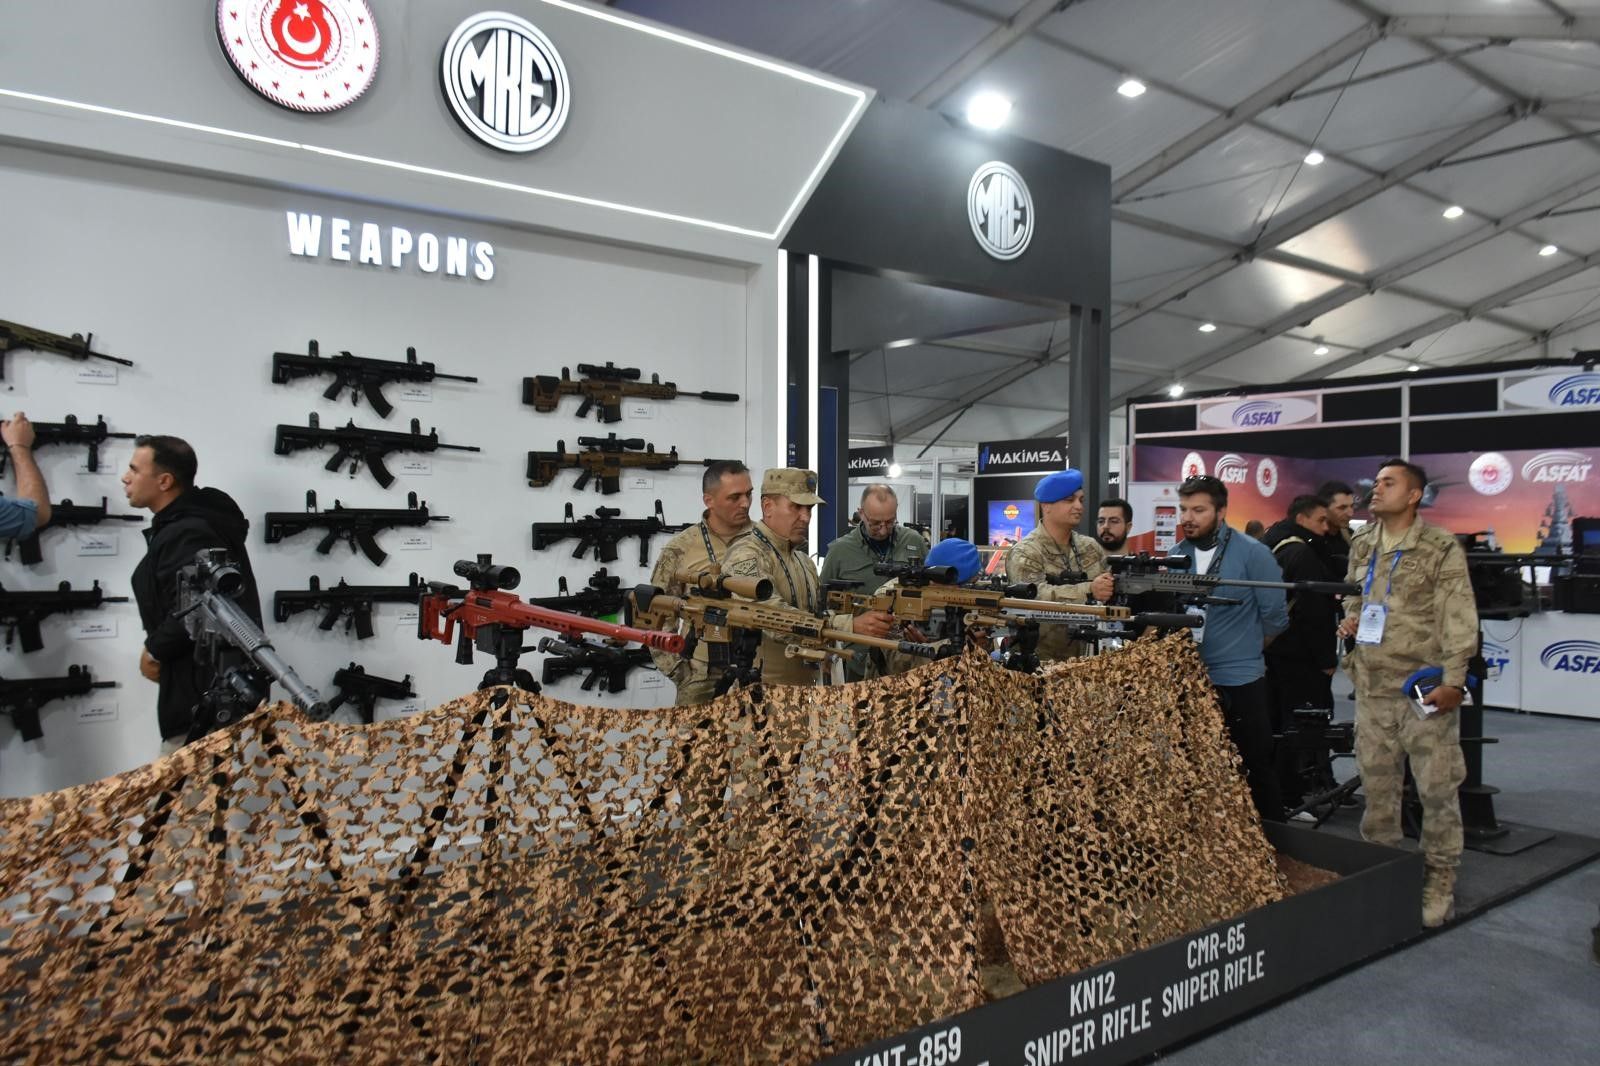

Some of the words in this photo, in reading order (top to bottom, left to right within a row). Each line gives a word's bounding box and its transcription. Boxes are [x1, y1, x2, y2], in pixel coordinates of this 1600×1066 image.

[460, 29, 552, 136] MKE
[976, 173, 1025, 250] MKE
[286, 211, 494, 281] WEAPONS
[1561, 388, 1600, 405] ASF
[1241, 411, 1282, 427] ASFAT
[848, 457, 889, 469] KİMSA
[988, 449, 1062, 464] MAKİMSA
[1220, 467, 1248, 484] ASFAT
[1533, 464, 1592, 482] ASFAT
[1187, 922, 1246, 970] CMR-65
[1070, 970, 1116, 1018] KN12
[1162, 968, 1220, 1018] SNIPER
[1224, 950, 1265, 993] RIFLE
[854, 1026, 962, 1066] T-859
[1024, 1019, 1096, 1066] SNIPER
[1101, 997, 1152, 1046] RIFLE
